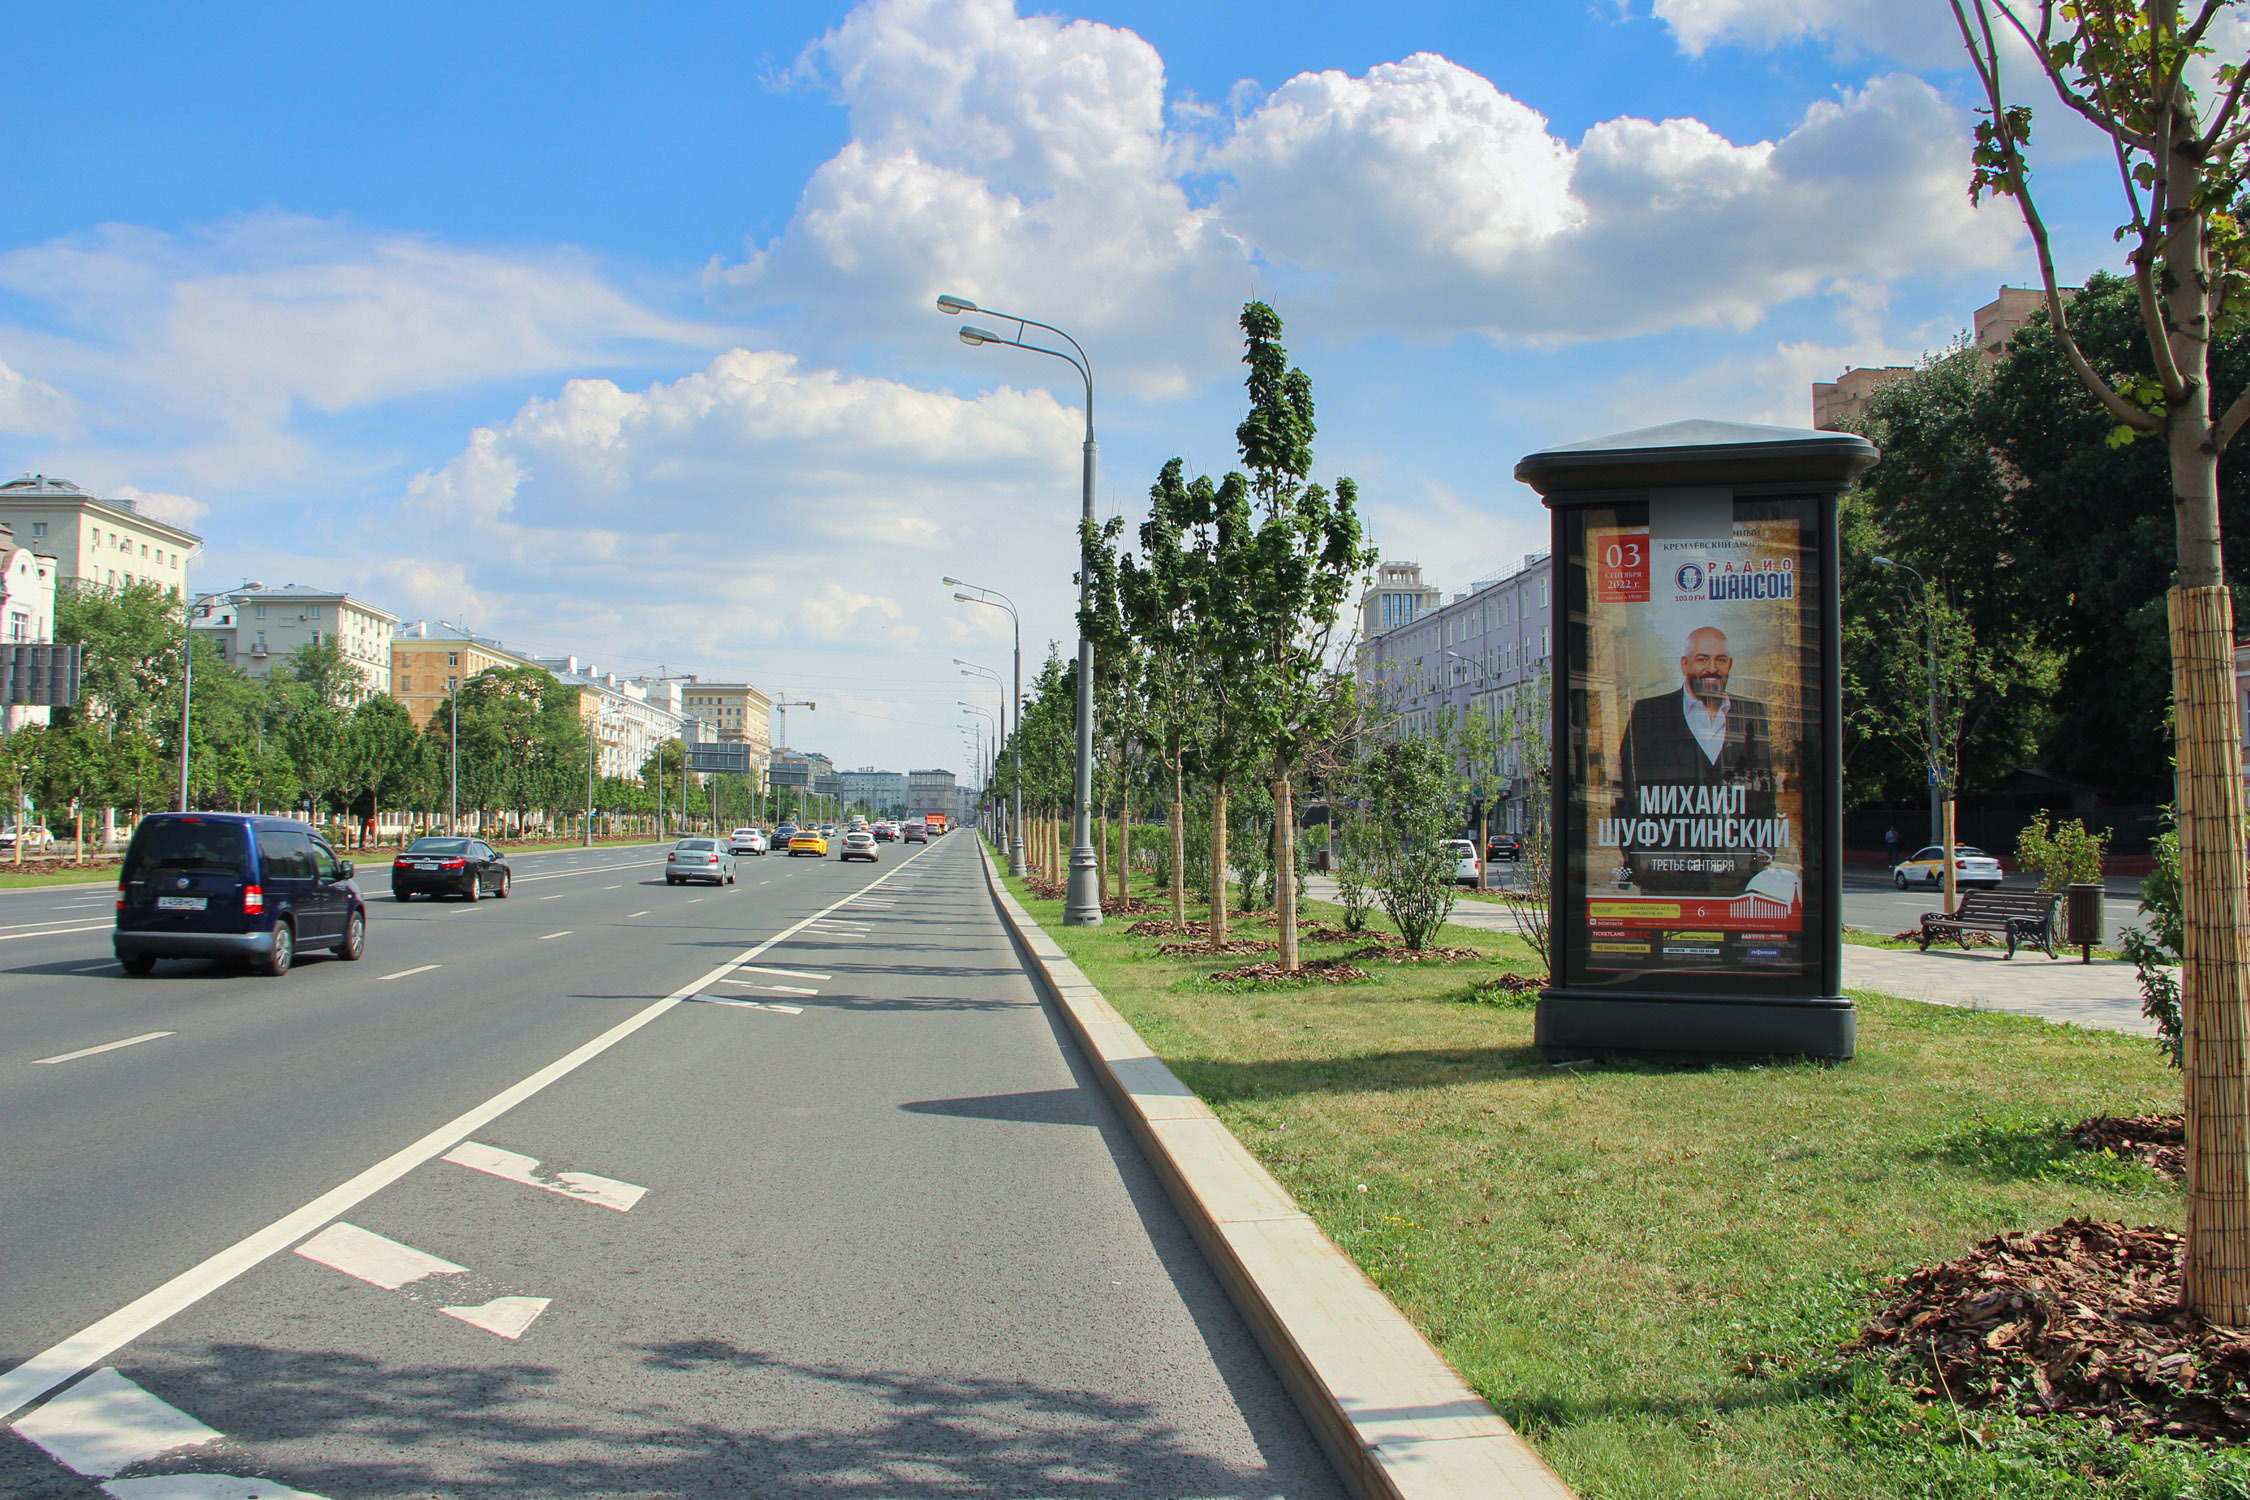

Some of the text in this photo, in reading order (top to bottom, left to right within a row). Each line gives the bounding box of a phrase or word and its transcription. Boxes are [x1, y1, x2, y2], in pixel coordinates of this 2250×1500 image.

[1606, 543, 1641, 568] 03
[1605, 571, 1642, 579] СЕНТЯБРЯ
[1708, 559, 1792, 573] РАДИО
[1607, 580, 1632, 589] 2022
[1708, 573, 1792, 600] ШАНСОН
[1640, 785, 1746, 815] МИХАИЛ
[1598, 812, 1790, 848] ШУФУТИНСКИЙ
[1651, 858, 1735, 872] ТРЕТЬЕ СЕНТЯБРЯ
